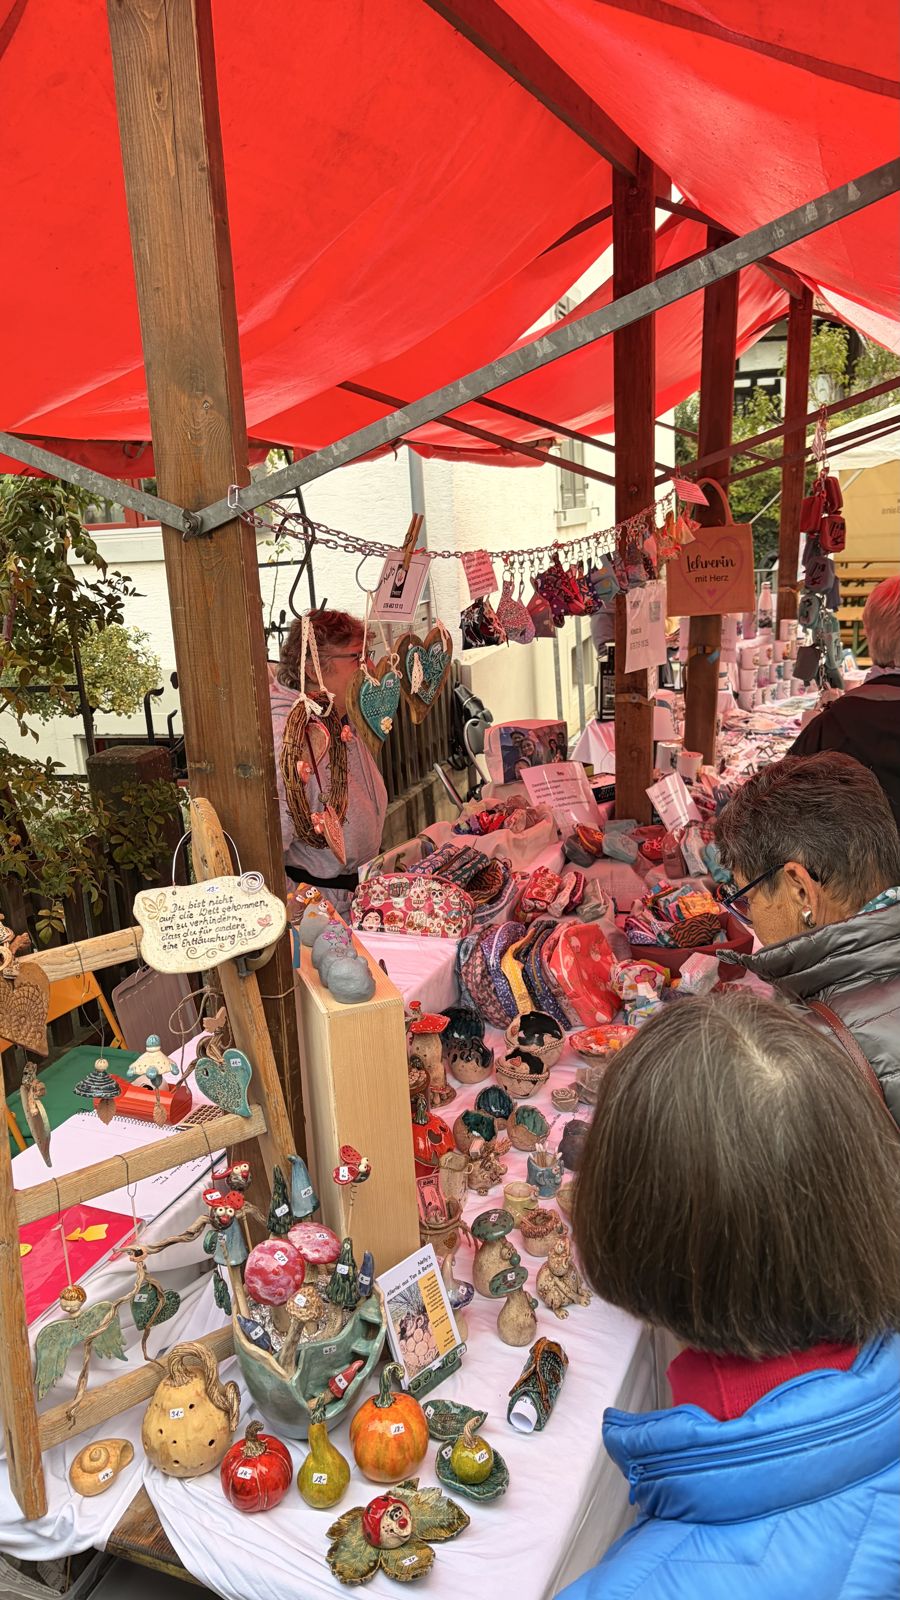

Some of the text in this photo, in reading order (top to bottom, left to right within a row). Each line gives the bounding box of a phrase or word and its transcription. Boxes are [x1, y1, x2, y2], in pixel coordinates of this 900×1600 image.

[686, 554, 736, 573] Lehrerin
[695, 574, 729, 583] mit Herz
[170, 894, 233, 913] Du bist nicht
[159, 914, 176, 923] auf
[179, 910, 194, 920] die
[199, 906, 220, 917] Welt
[160, 924, 174, 932] um
[176, 922, 188, 930] zu
[161, 922, 246, 942] dass du für andere
[162, 927, 257, 951] eine Enttäuschung bist
